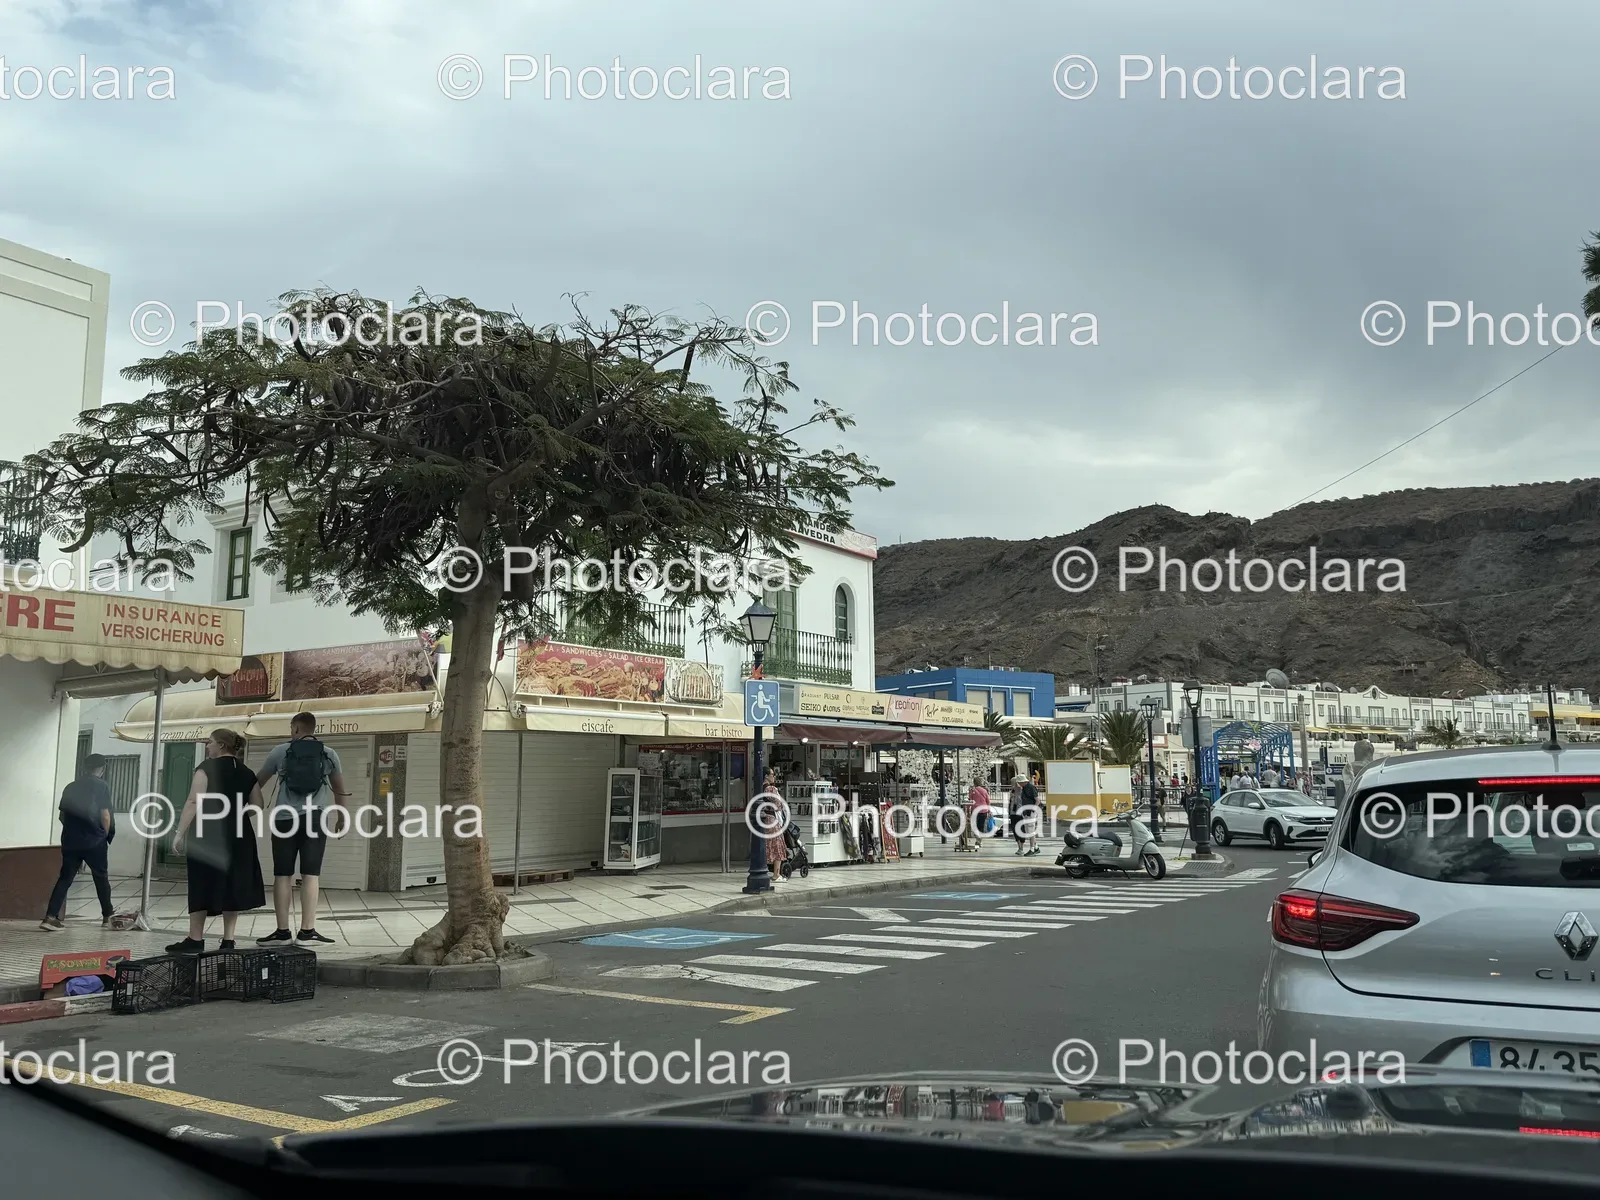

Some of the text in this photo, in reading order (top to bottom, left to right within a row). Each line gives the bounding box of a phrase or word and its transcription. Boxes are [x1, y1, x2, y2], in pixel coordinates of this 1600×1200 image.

[0, 593, 75, 632] RE
[106, 603, 222, 628] INSURANCE
[101, 622, 225, 647] VERSICHERUNG
[322, 644, 364, 657] SANDWICHES
[370, 642, 394, 652] SALAD
[561, 646, 602, 658] SANDWICHES
[608, 652, 628, 660] SALAD
[634, 655, 643, 663] ICE
[644, 656, 664, 665] CREAM
[800, 702, 821, 712] SEIKO
[329, 719, 359, 733] bistro
[581, 718, 614, 733] eiscafe
[705, 723, 743, 738] bar bistro
